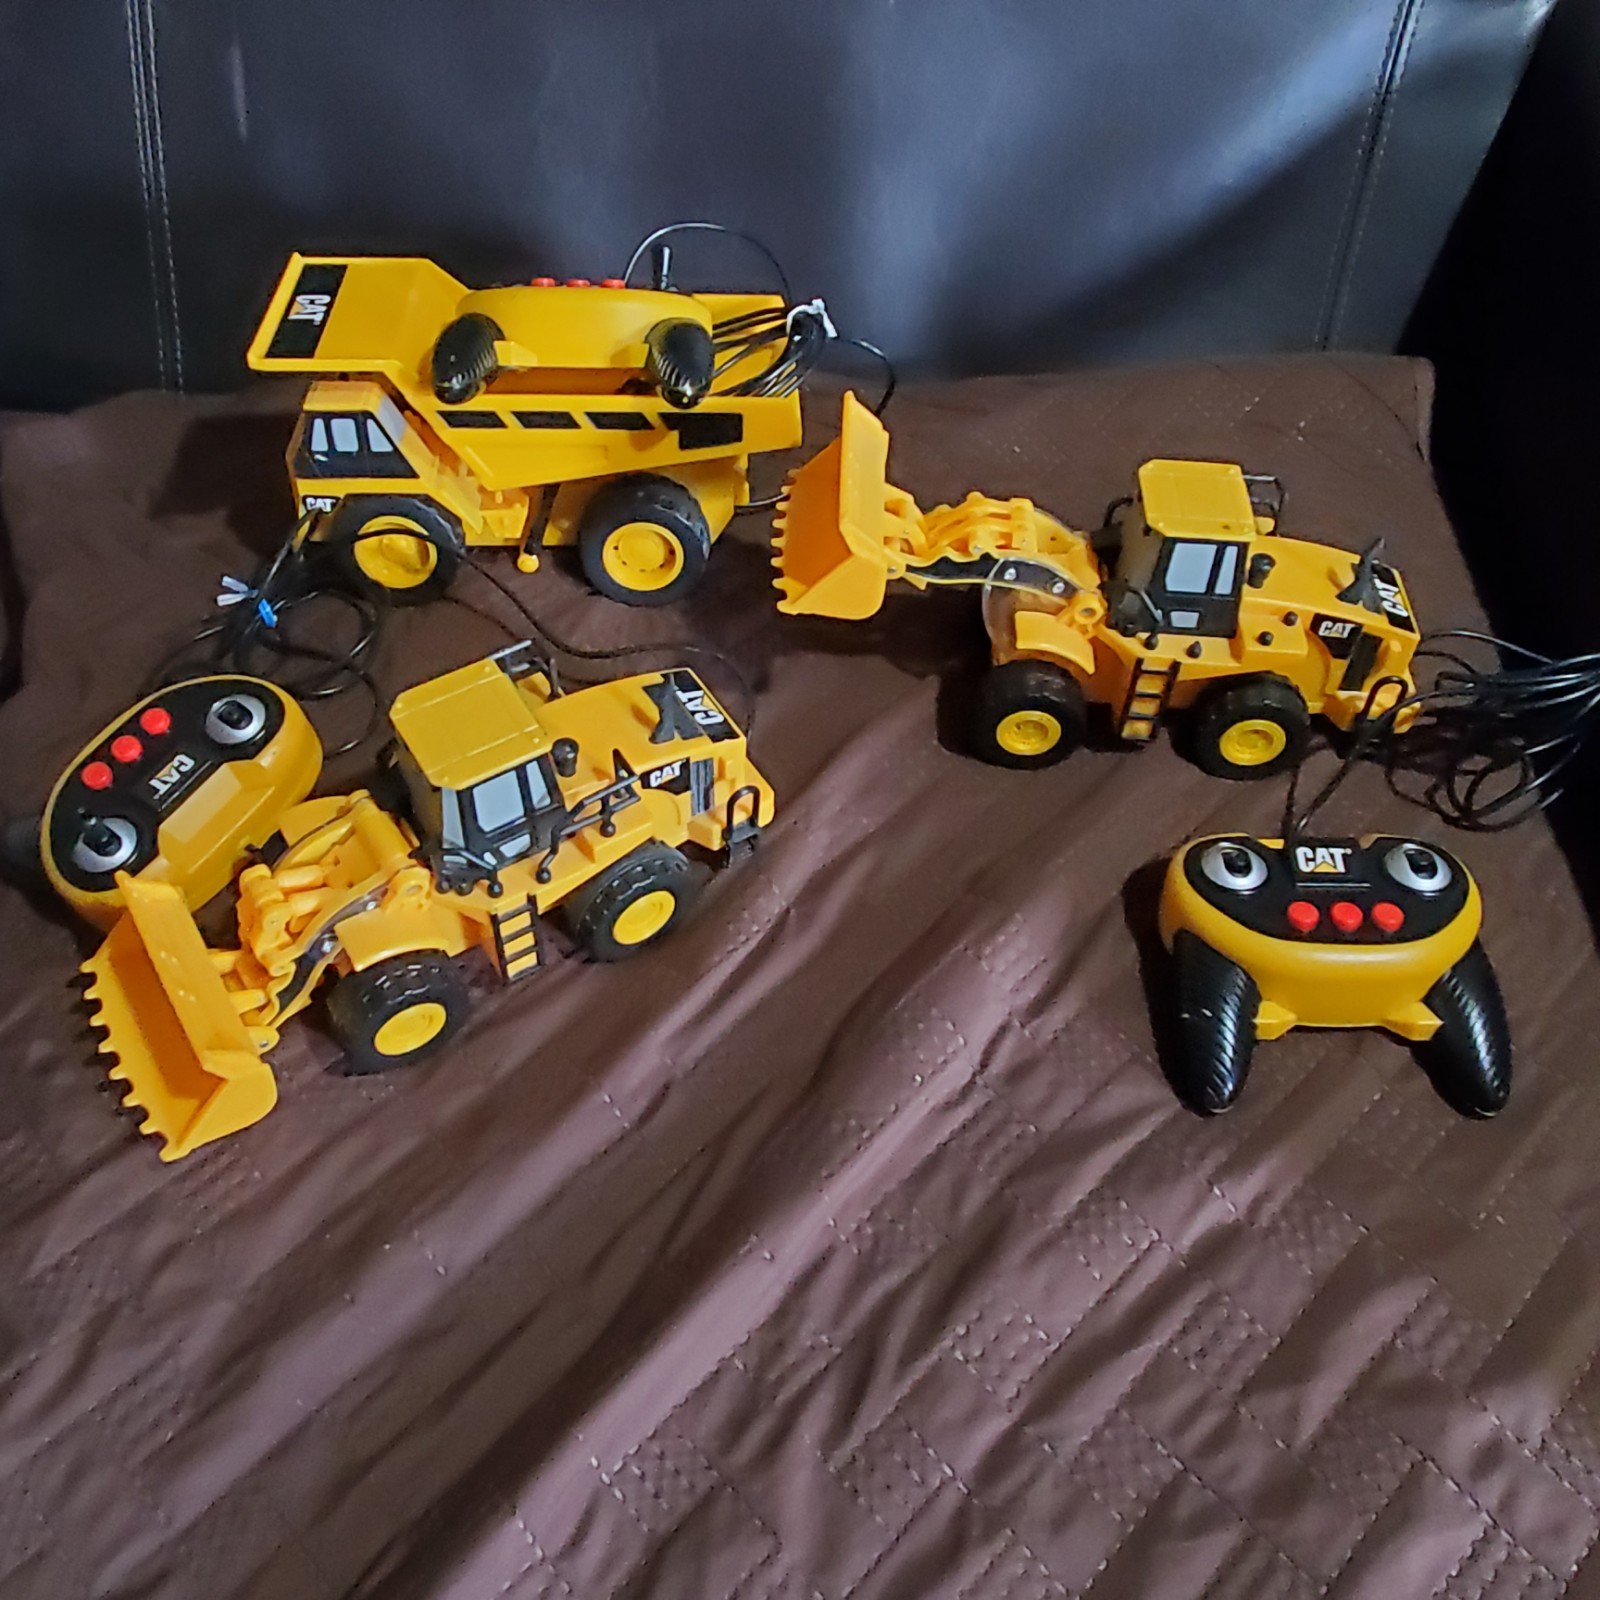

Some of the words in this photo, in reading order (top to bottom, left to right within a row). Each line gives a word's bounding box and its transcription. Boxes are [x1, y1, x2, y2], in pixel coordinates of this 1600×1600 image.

[288, 293, 331, 325] CAT
[305, 497, 334, 512] CAT
[1374, 580, 1409, 617] CAT
[1318, 620, 1353, 639] CAT
[675, 689, 724, 726] CAT
[149, 754, 196, 796] CAT
[649, 761, 682, 788] CAT
[1295, 846, 1347, 873] CAT
